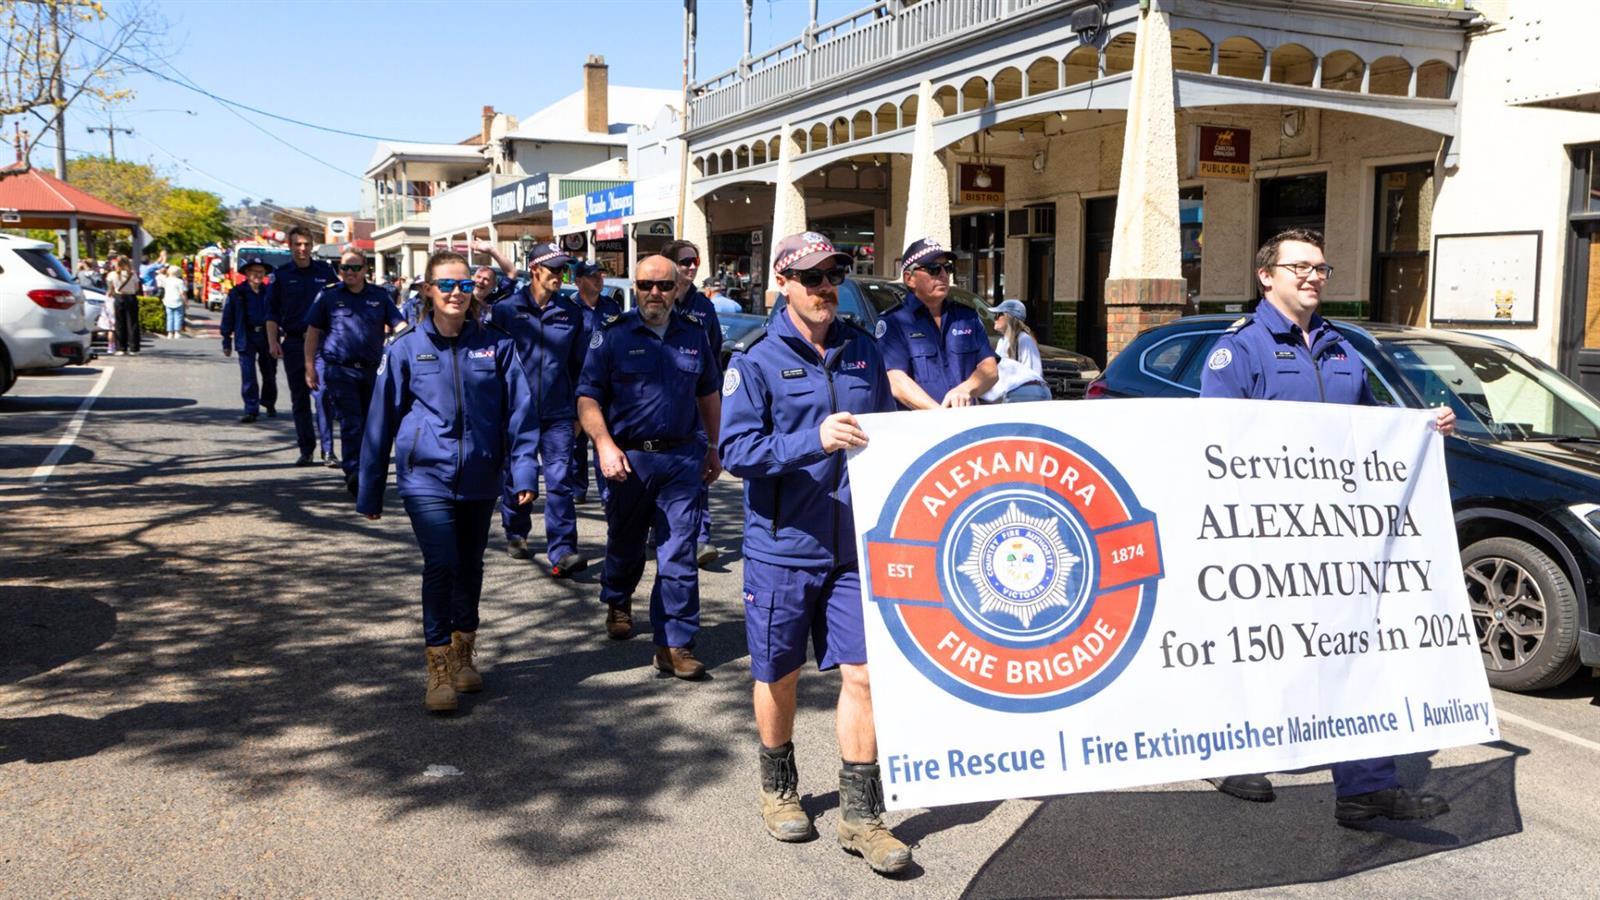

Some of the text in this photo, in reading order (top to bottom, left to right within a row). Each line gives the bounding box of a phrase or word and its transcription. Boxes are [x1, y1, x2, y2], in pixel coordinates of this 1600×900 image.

[1201, 163, 1246, 176] PUBLIC BAR
[965, 193, 1000, 202] BISTRO
[921, 451, 1097, 517] ALEXANDRA
[1204, 444, 1408, 493] Servicing the
[1197, 503, 1422, 540] ALEXANDRA
[887, 563, 914, 578] EST
[986, 529, 1053, 577] COUNTRY FIRE AUTHORITY
[1111, 544, 1145, 564] 1874
[1002, 585, 1045, 599] VICTORIA
[1197, 560, 1432, 601] COMMUNITY
[937, 618, 1117, 684] FIRE BRIGADE
[1160, 613, 1471, 668] for 150 Years in 2024
[888, 699, 1490, 784] Fire Rescue Fire Extinguisher Maintenance Auxiliary
